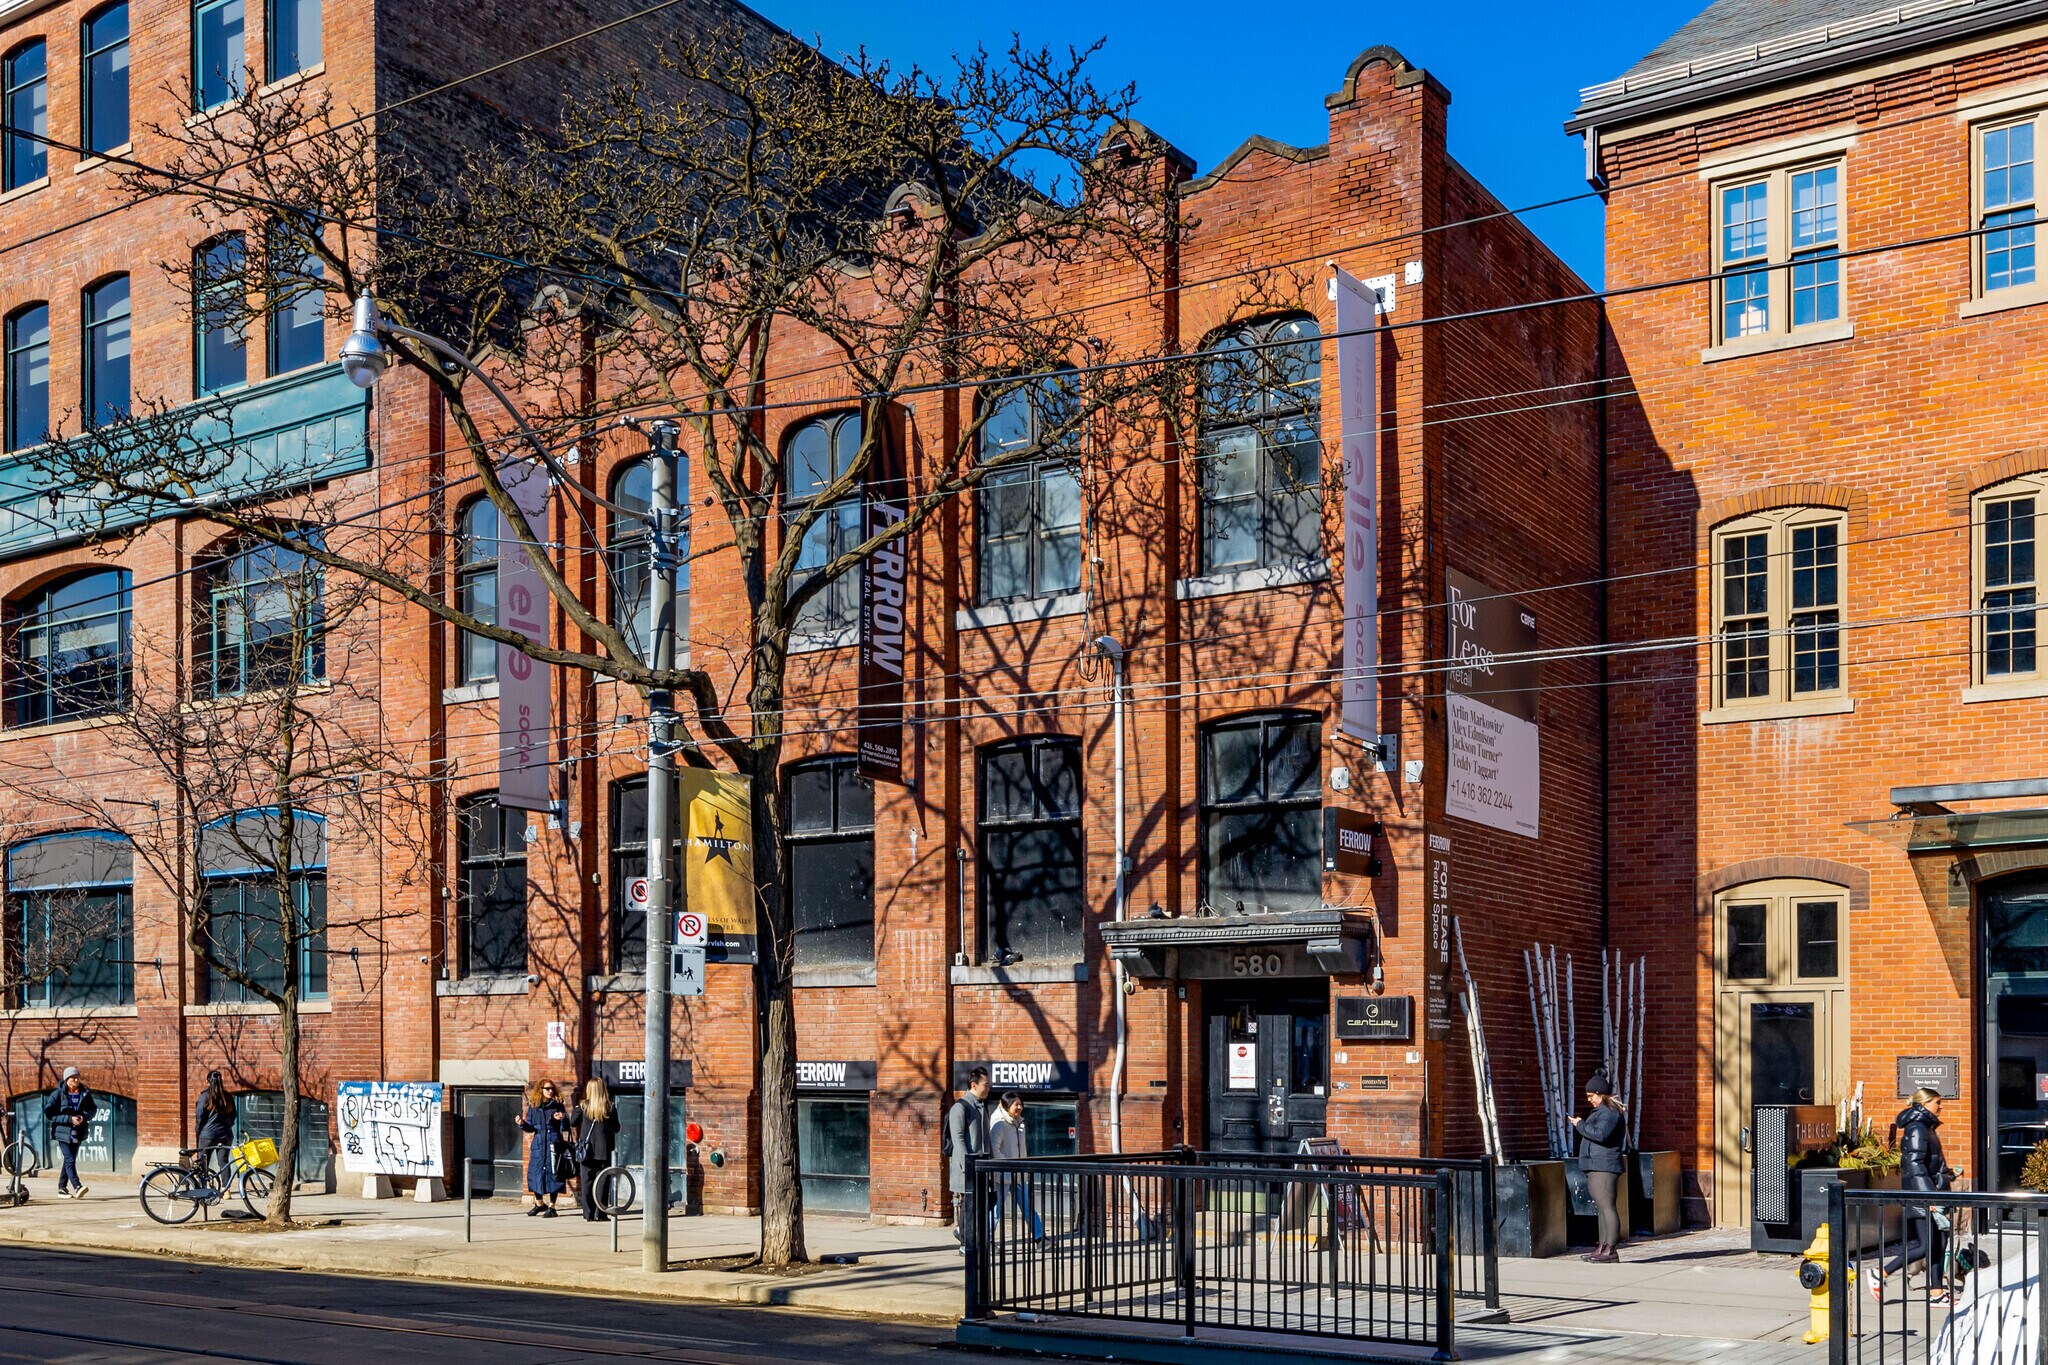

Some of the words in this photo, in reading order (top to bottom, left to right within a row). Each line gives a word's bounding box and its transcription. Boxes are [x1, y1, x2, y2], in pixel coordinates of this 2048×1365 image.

[1349, 444, 1371, 572] elle
[1450, 585, 1476, 631] For
[1520, 612, 1536, 629] CBRE
[508, 584, 541, 681] ele
[1356, 603, 1364, 695] SOCIAL
[1452, 623, 1495, 676] Lease
[1450, 662, 1472, 688] Retail
[1451, 704, 1469, 721] Arlin
[1452, 720, 1466, 737] Alex
[1451, 735, 1476, 754] Jackson
[1477, 743, 1499, 763] Turner
[1452, 753, 1471, 775] Teddy
[1473, 760, 1497, 780] Taggart
[1462, 780, 1475, 800] 416
[1478, 786, 1492, 806] 362
[1494, 791, 1513, 812] 2244
[684, 837, 750, 852] HAMILTON
[1339, 828, 1371, 852] FERROW
[1429, 834, 1450, 851] FERROW
[1440, 861, 1448, 899] FOR
[1432, 904, 1440, 949] Space
[1440, 904, 1449, 963] LEASE
[1233, 954, 1281, 976] 580
[619, 1062, 646, 1080] FERR
[991, 1063, 1052, 1083] FERROW
[371, 1081, 433, 1102] Notice
[1796, 1123, 1812, 1140] THE
[1815, 1122, 1831, 1139] KEG
